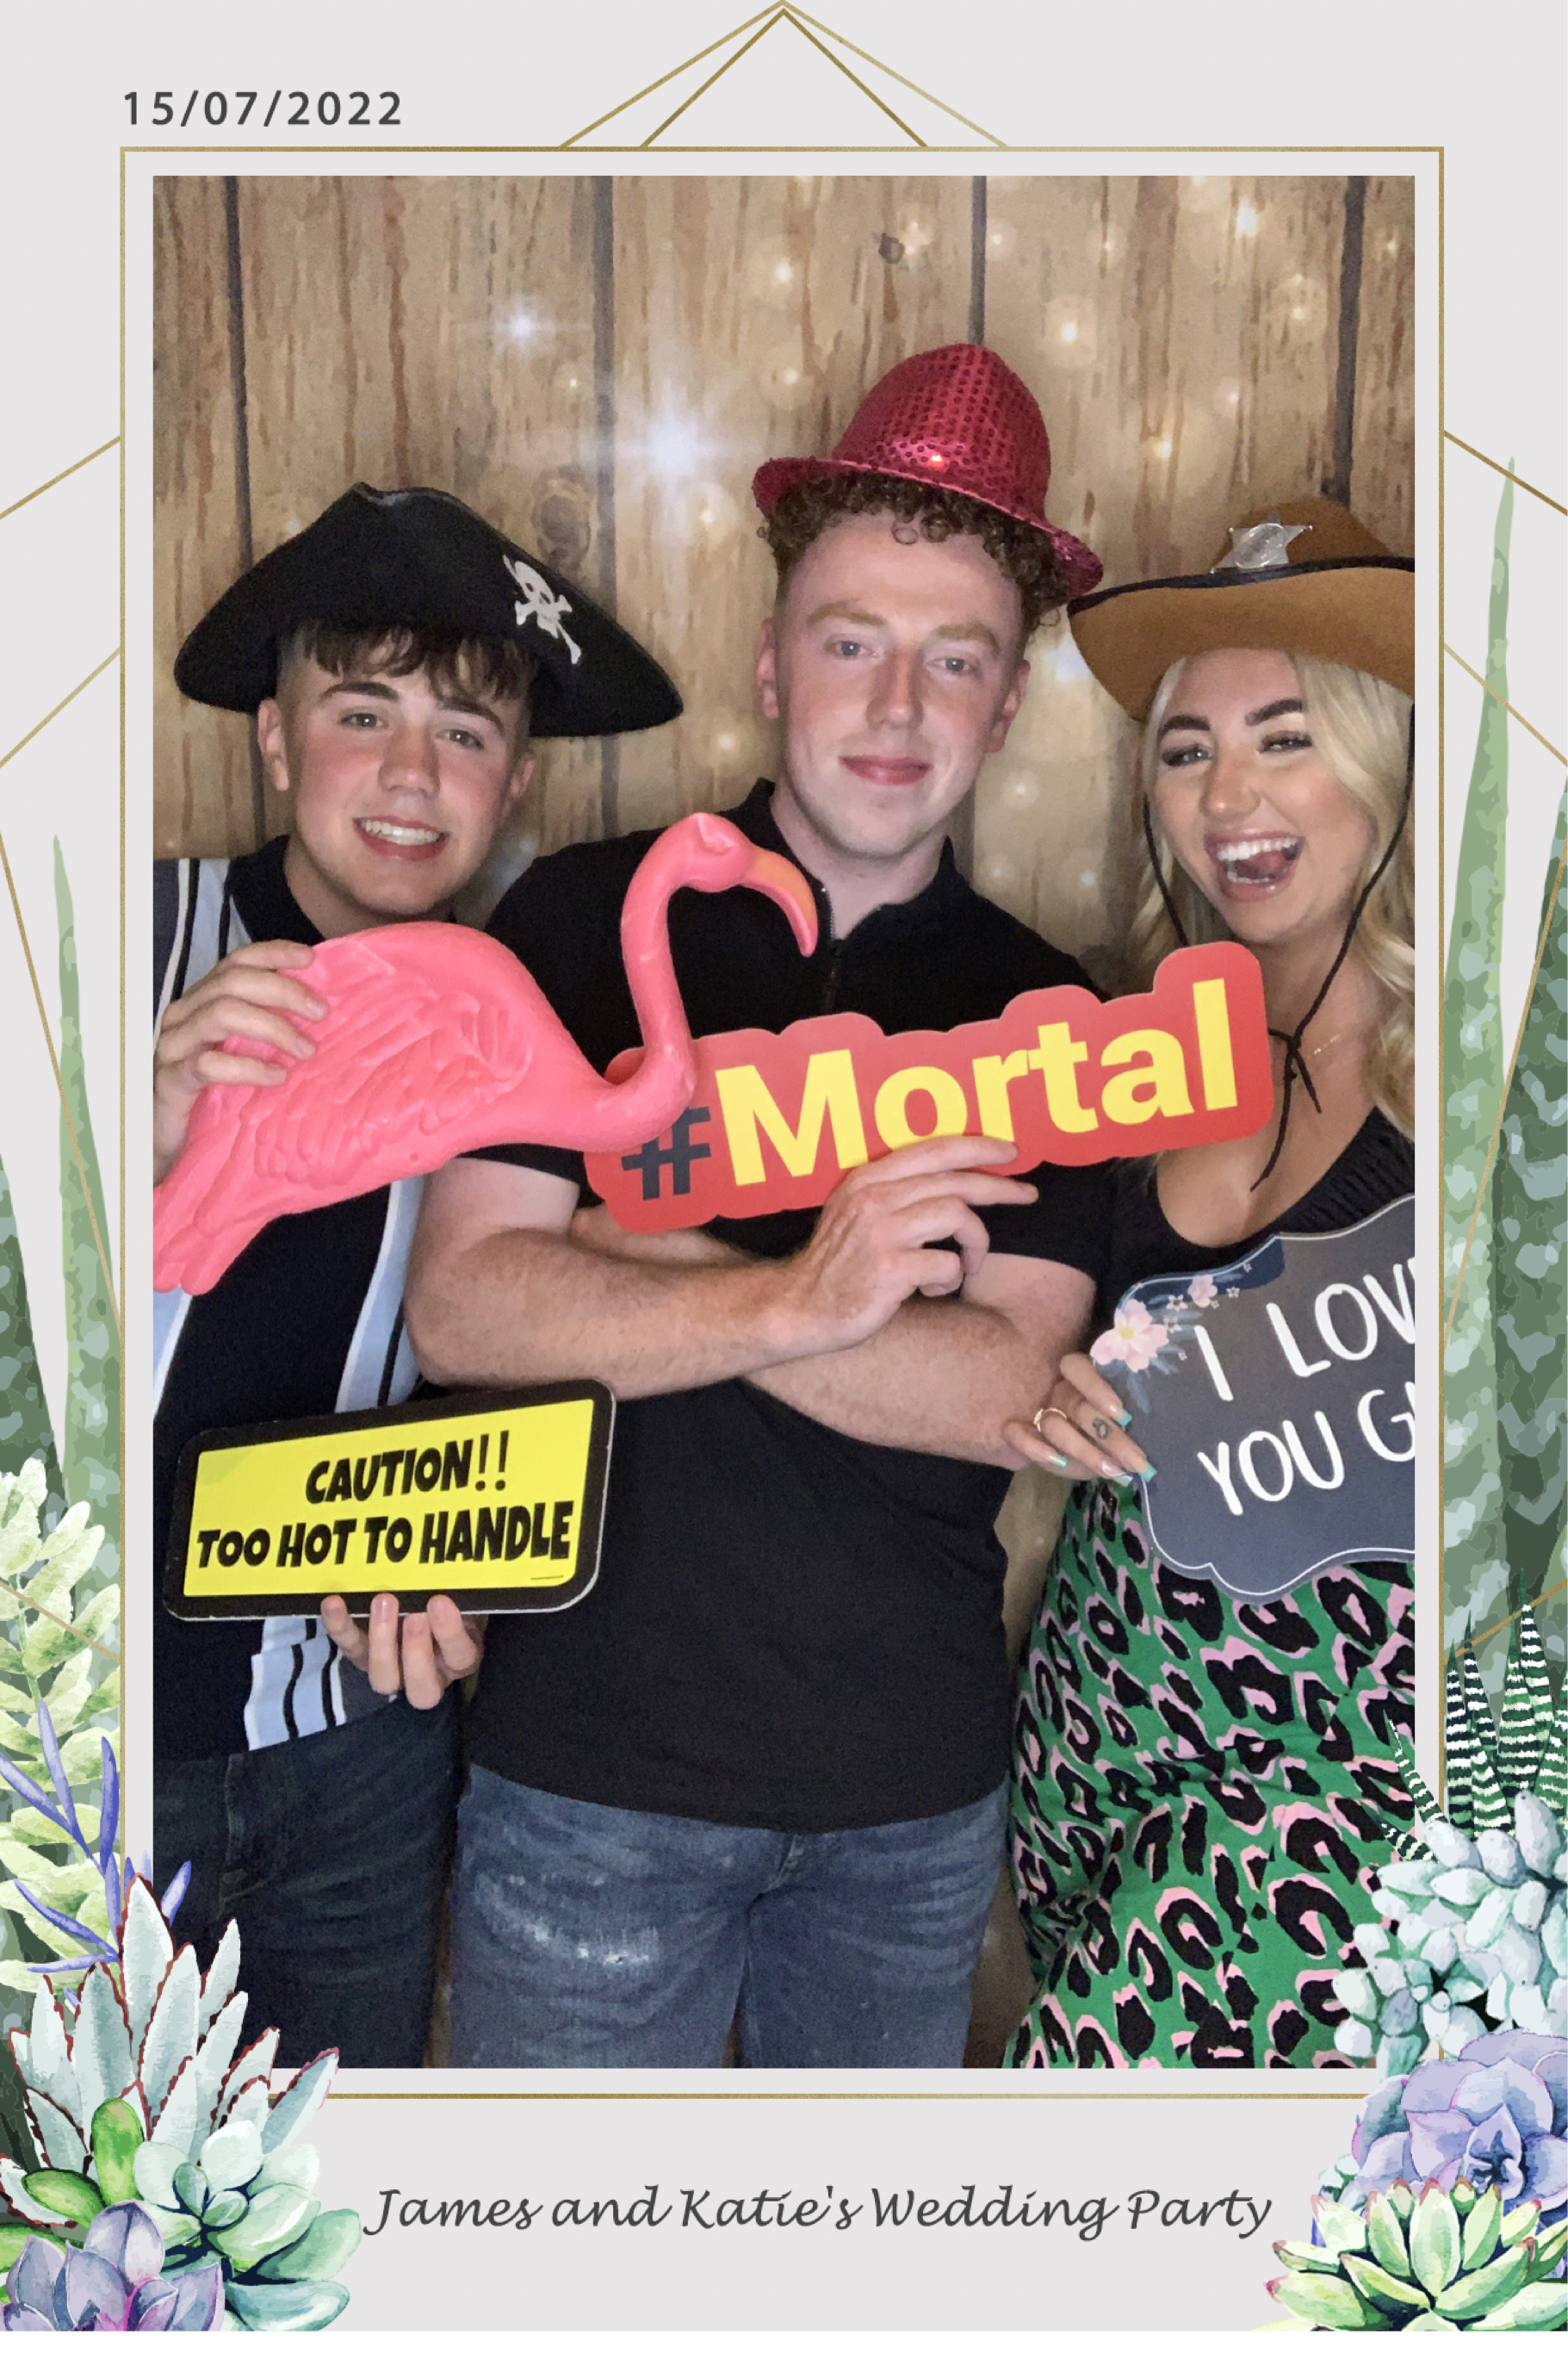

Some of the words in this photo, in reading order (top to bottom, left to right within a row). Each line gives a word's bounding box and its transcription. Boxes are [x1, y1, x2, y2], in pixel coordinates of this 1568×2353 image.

[621, 978, 1238, 1201] #Mortal
[1193, 1324, 1234, 1402] I
[1266, 1256, 1415, 1378] LOV
[305, 1429, 510, 1505] CAUTION!!
[1197, 1409, 1346, 1517] YOU
[1357, 1381, 1415, 1462] G
[196, 1528, 271, 1569] TOO
[276, 1518, 357, 1568] HOT
[364, 1516, 413, 1565] TO
[418, 1499, 575, 1565] HANDLE
